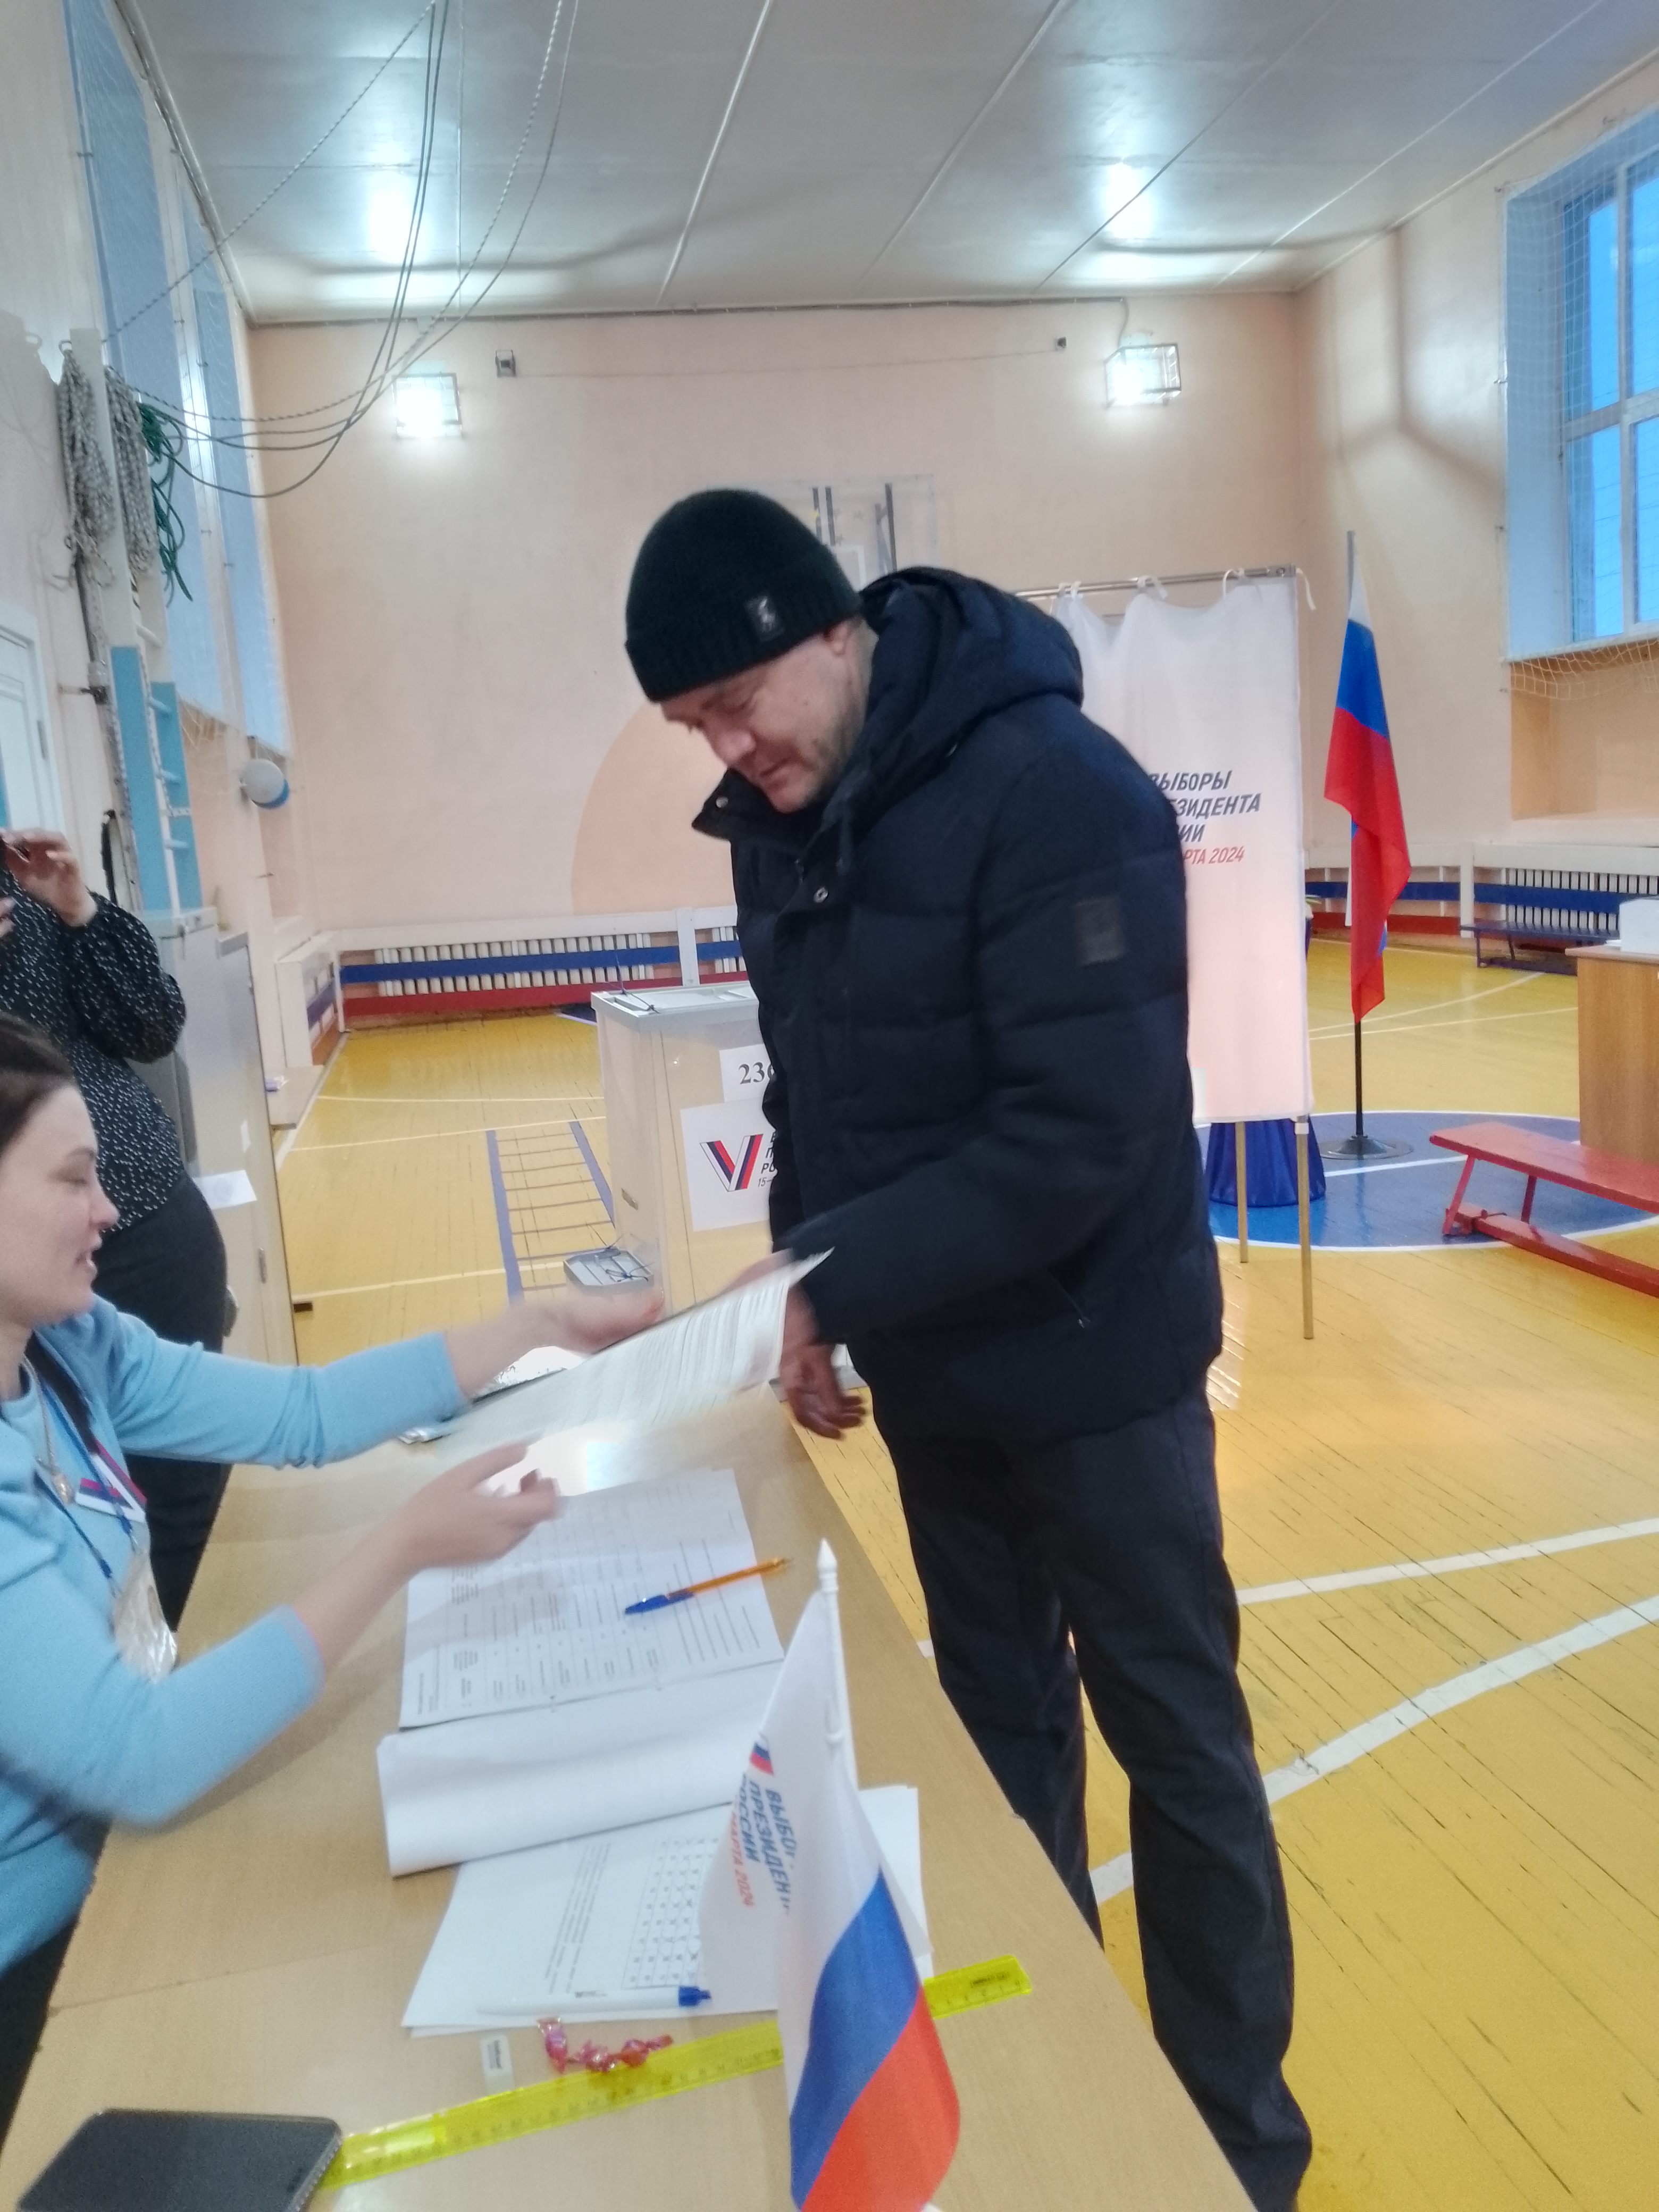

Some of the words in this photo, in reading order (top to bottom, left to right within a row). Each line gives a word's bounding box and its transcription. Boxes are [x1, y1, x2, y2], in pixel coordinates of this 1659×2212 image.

[1170, 793, 1261, 819] ЗИДЕНТА
[1179, 824, 1206, 842] ИИ
[1183, 848, 1206, 865] РТА
[1208, 845, 1245, 864] 2024
